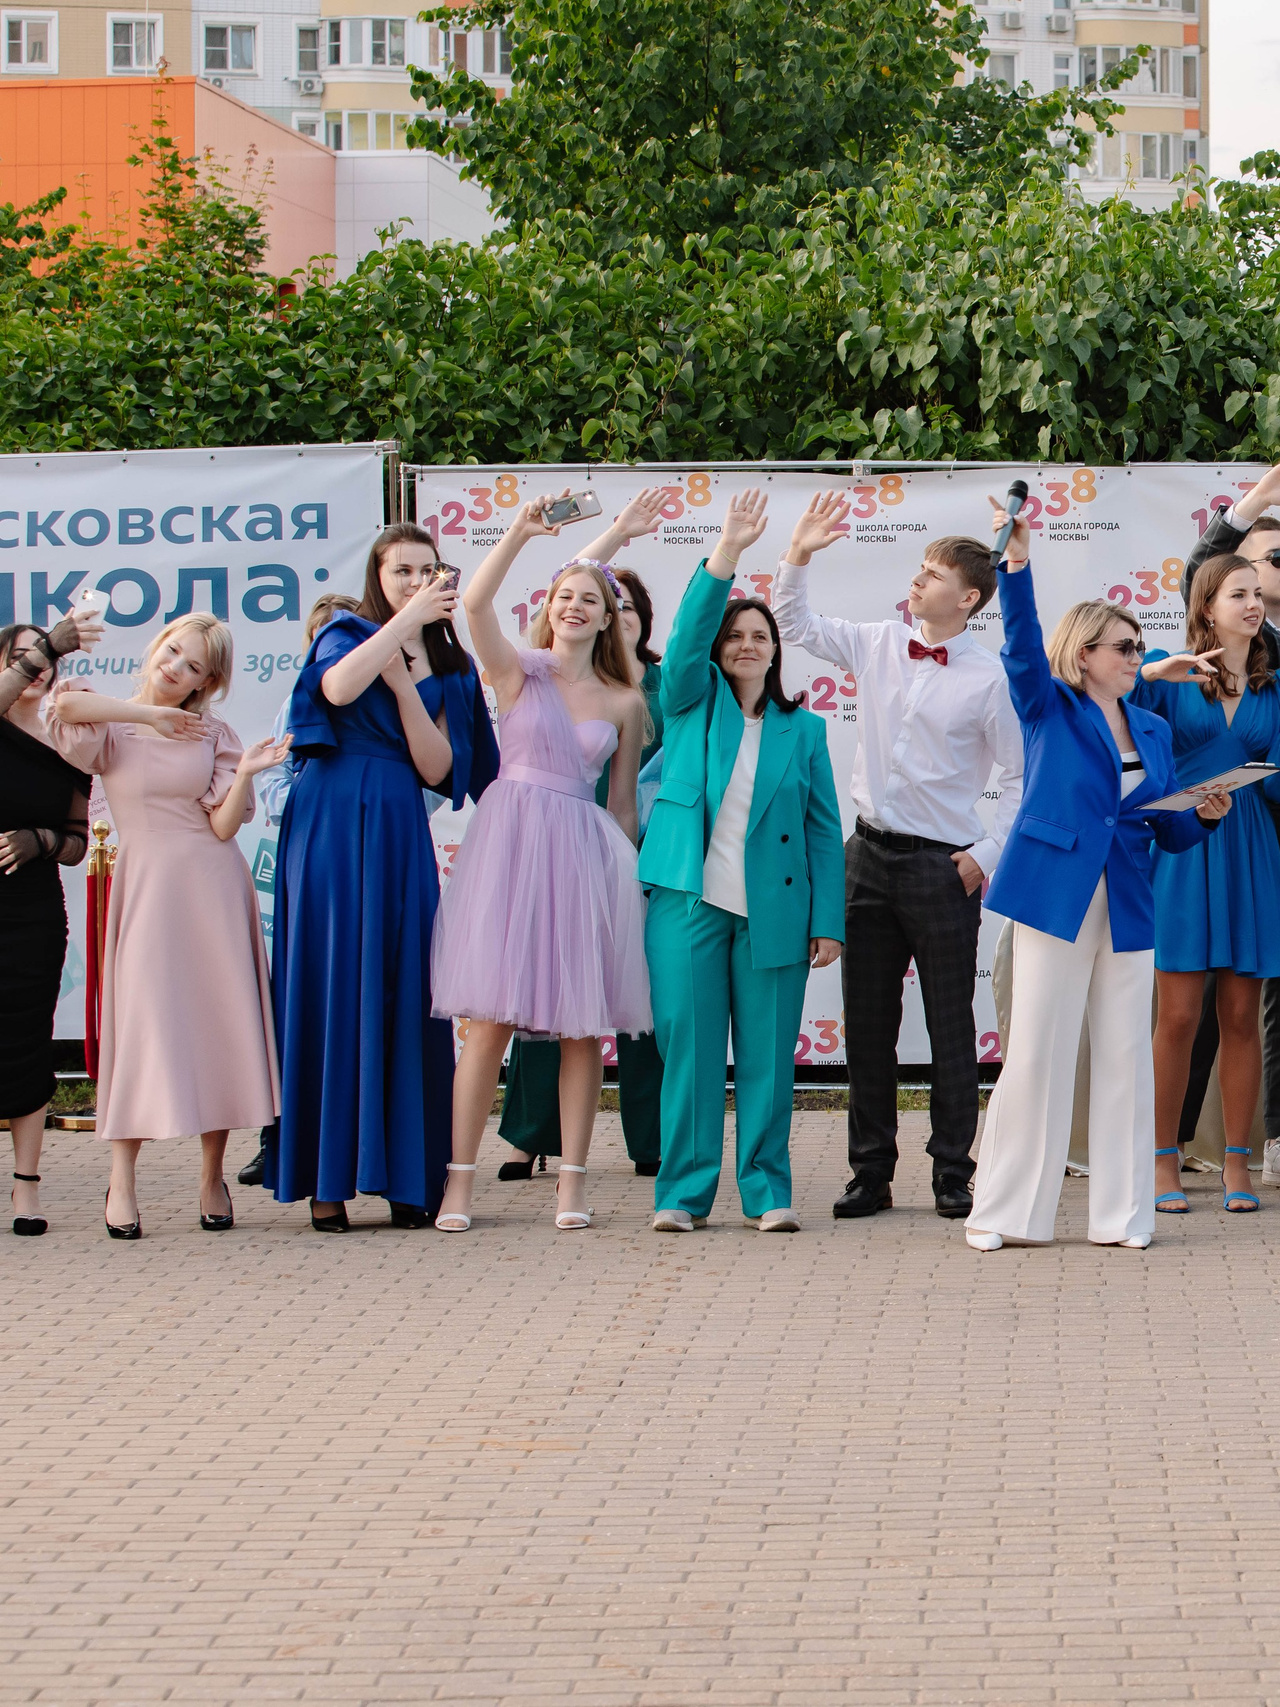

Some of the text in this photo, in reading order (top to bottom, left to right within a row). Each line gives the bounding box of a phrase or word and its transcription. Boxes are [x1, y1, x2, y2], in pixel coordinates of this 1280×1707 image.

[828, 475, 905, 532] 238
[1020, 468, 1098, 530] 238
[422, 473, 520, 549] 1238
[0, 502, 329, 548] сковская
[663, 525, 723, 534] ШКОЛА ГОРО
[856, 523, 928, 532] ШКОЛА ГОРОДА
[1049, 522, 1120, 531] ШКОЛА ГОРОДА
[472, 528, 505, 536] ШКОЛА
[663, 537, 704, 545] МОСКВЫ
[856, 535, 897, 543] МОСКВЫ
[1049, 533, 1089, 541] МОСКВЫ
[472, 539, 501, 547] МОСК
[1095, 557, 1185, 608] 238
[1139, 611, 1172, 619] ШКОЛА
[1140, 622, 1179, 630] МОСКВЫ
[243, 652, 305, 684] здес
